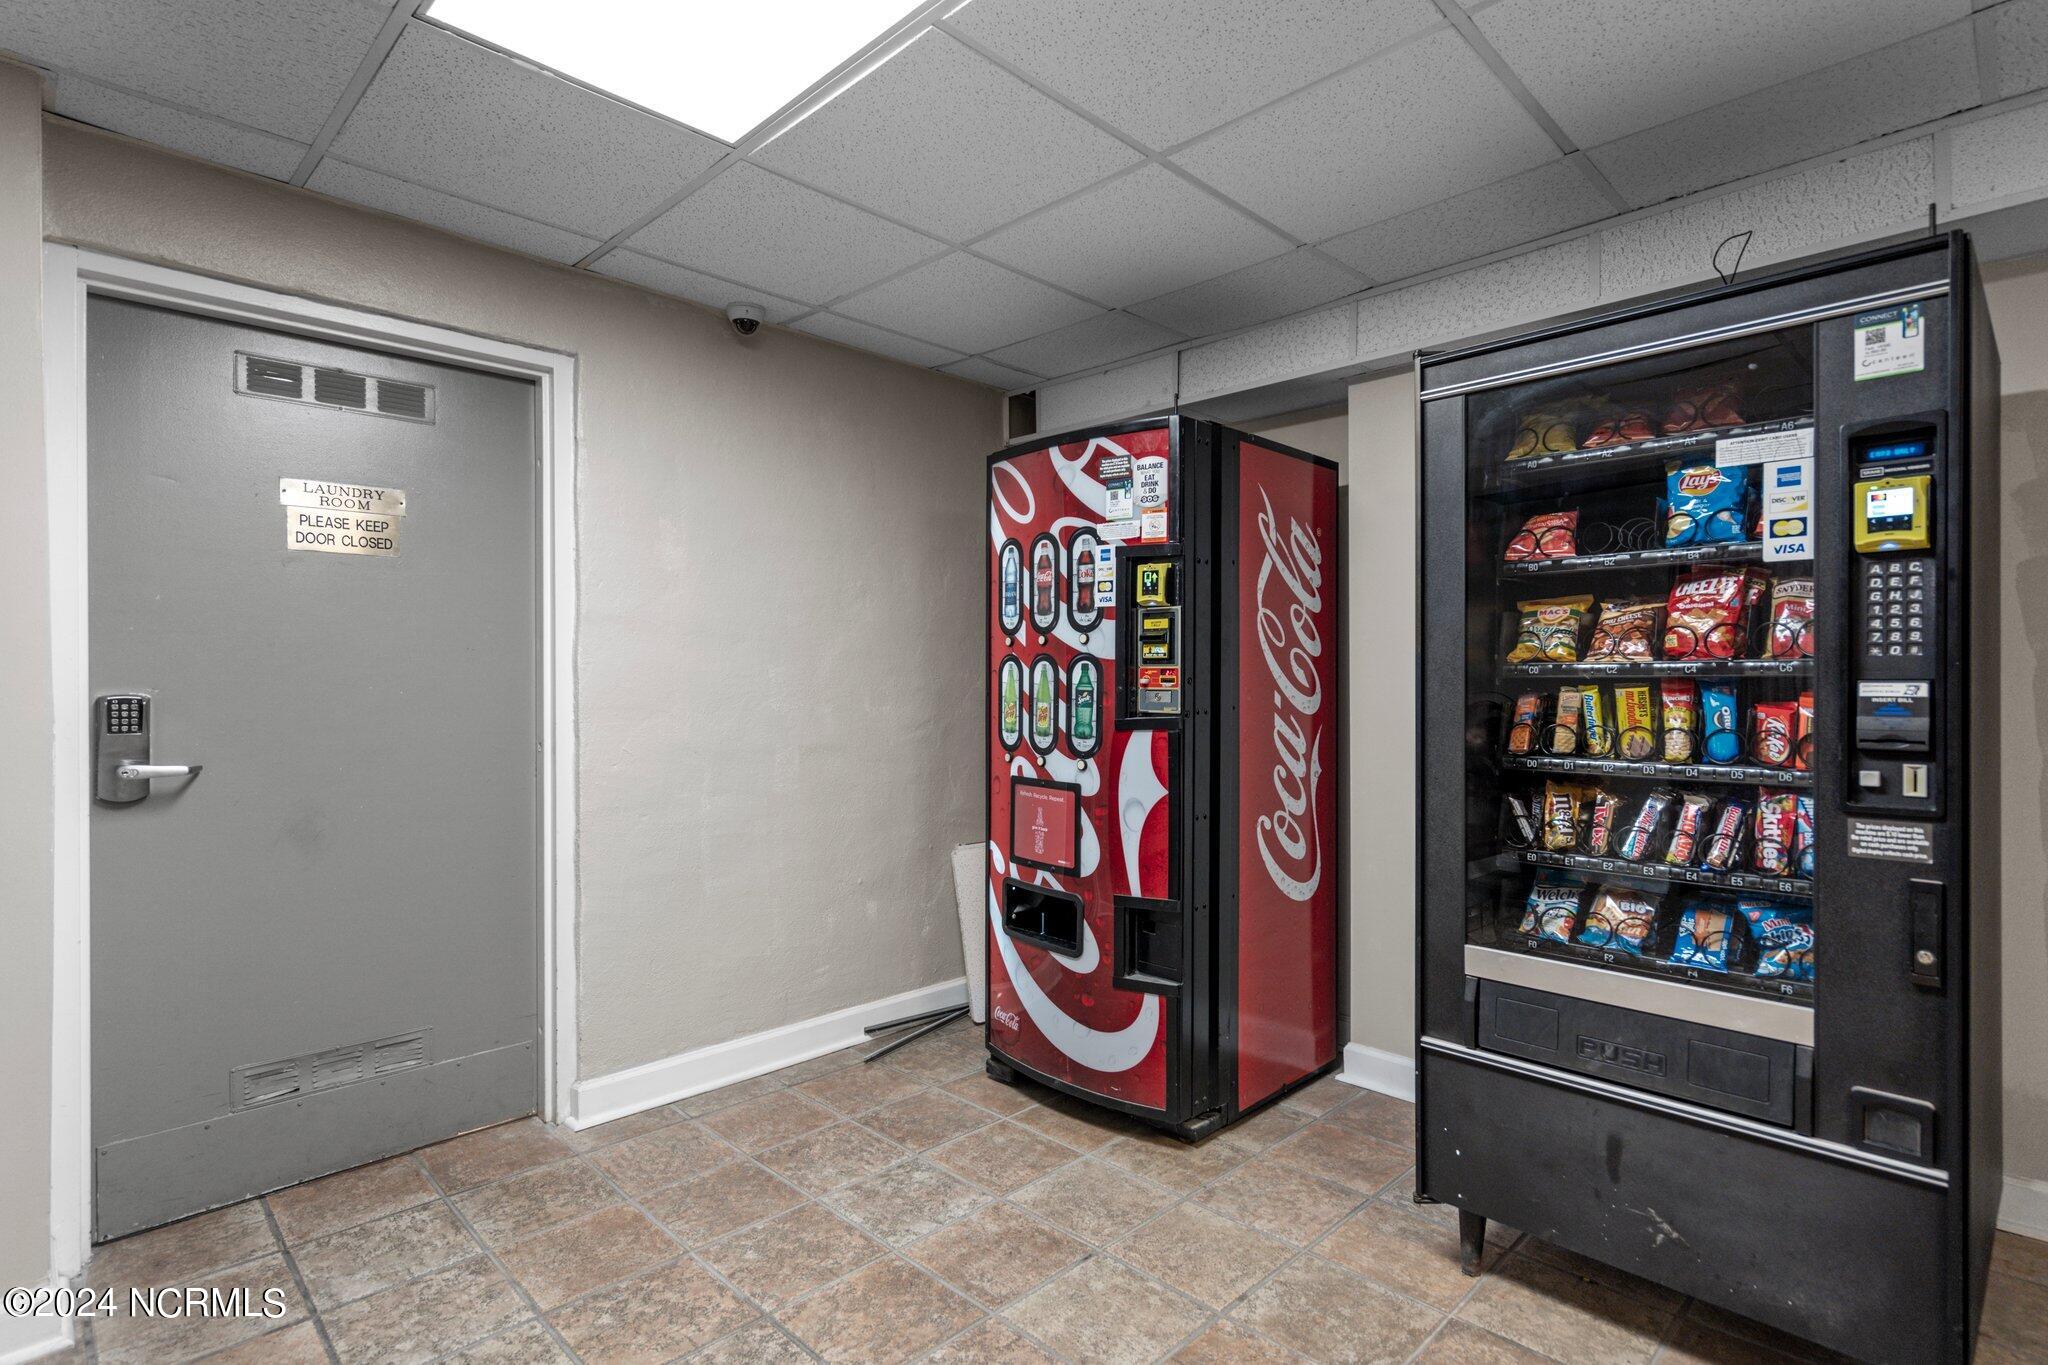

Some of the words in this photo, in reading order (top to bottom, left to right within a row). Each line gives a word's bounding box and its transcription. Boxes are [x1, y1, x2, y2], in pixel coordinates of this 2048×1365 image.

[1859, 310, 1898, 323] CONNECT
[1684, 436, 1696, 446] A4
[1601, 448, 1613, 458] A2
[1136, 461, 1164, 471] BALANCE
[1527, 460, 1538, 469] A0
[1141, 480, 1159, 488] DRINK
[303, 482, 386, 501] LAUNDRY
[319, 496, 371, 511] ROOM
[1771, 495, 1805, 504] DISCVER
[299, 514, 350, 530] PLEASE
[356, 519, 389, 533] KEEP
[295, 531, 336, 546] DOOR
[341, 535, 393, 550] CLOSED
[1774, 543, 1805, 555] VISA
[1528, 563, 1539, 571] B0
[1604, 558, 1615, 566] B2
[1869, 564, 1881, 574] A
[1889, 563, 1901, 573] B
[1908, 561, 1920, 572] C
[1869, 578, 1881, 588] D
[1889, 577, 1900, 587] E
[1909, 575, 1920, 585] F
[1869, 591, 1881, 601] G
[1889, 590, 1901, 601] H
[1909, 589, 1921, 599] J
[1538, 607, 1569, 617] MAC'S
[1872, 605, 1880, 615] 1
[1889, 604, 1901, 614] 2
[1909, 603, 1921, 613] 3
[1617, 611, 1643, 624] CHEESE
[1870, 619, 1881, 628] 4
[1890, 618, 1901, 628] 5
[1909, 617, 1921, 627] 6
[1871, 632, 1881, 642] 7
[1890, 631, 1901, 642] 8
[1909, 631, 1920, 641] 9
[1528, 666, 1539, 674] C0
[1606, 666, 1618, 674] C2
[1684, 665, 1697, 673] C4
[1779, 663, 1793, 672] C6
[1257, 481, 1322, 902] Coca-Cola
[1637, 690, 1649, 718] HERSHEY'S
[1583, 693, 1598, 742] Butterfinger
[1722, 706, 1732, 733] ORE
[1526, 759, 1537, 768] D0
[1563, 761, 1574, 770] D1
[1602, 763, 1614, 773] D2
[1643, 765, 1655, 775] D3
[1685, 768, 1698, 777] D4
[1730, 770, 1744, 779] D5
[1778, 773, 1793, 782] D6
[1762, 801, 1783, 869] Skittles
[1851, 846, 1867, 854] Digital
[1867, 848, 1883, 856] display
[1526, 852, 1537, 862] E0
[1564, 857, 1574, 867] E1
[1602, 862, 1613, 871] E2
[1643, 866, 1654, 876] E3
[1685, 872, 1698, 881] E4
[1731, 877, 1743, 886] E5
[1779, 882, 1792, 892] E6
[1619, 900, 1647, 914] BIG
[1761, 917, 1791, 932] Mini
[1528, 940, 1537, 949] F0
[1604, 953, 1614, 963] F2
[1780, 985, 1793, 995] F6
[994, 1005, 1021, 1032] Coca-Cola
[1579, 1037, 1664, 1075] PUSH
